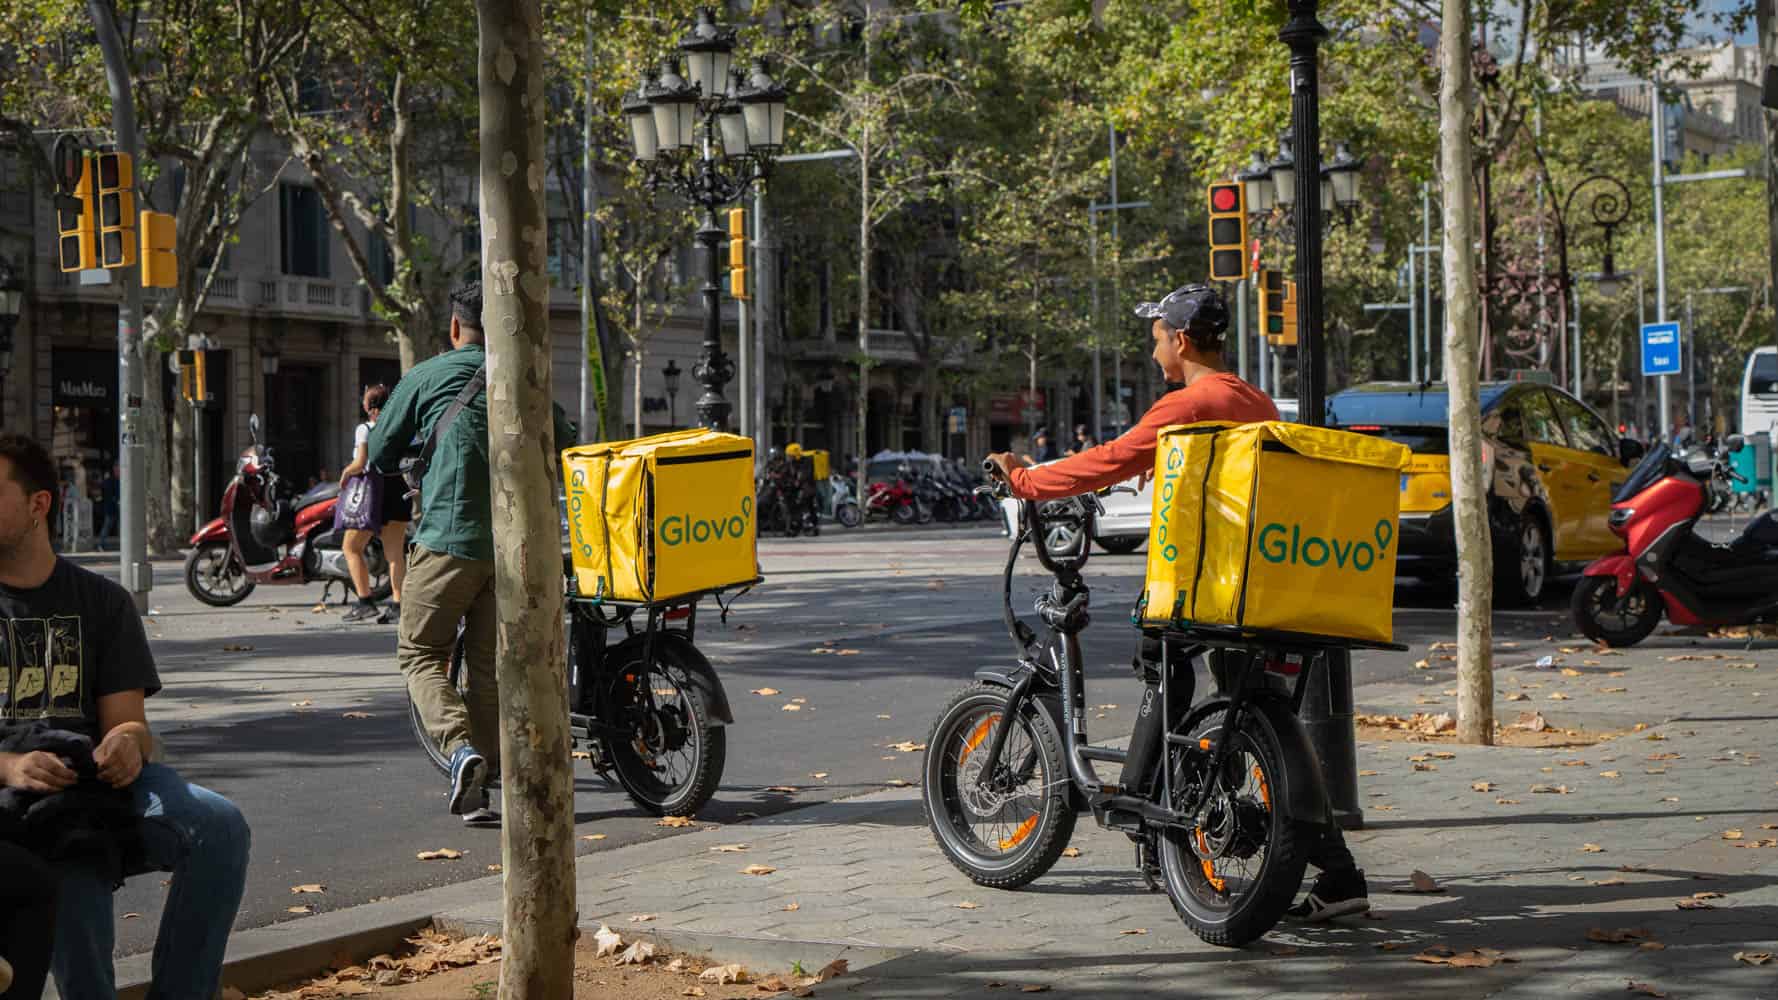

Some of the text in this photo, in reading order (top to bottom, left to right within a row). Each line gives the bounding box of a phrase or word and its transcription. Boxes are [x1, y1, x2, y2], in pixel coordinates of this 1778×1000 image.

[571, 469, 585, 546] Glovo
[1158, 447, 1184, 545] Glovo
[660, 513, 745, 546] Glovo
[1258, 522, 1375, 571] Glovo
